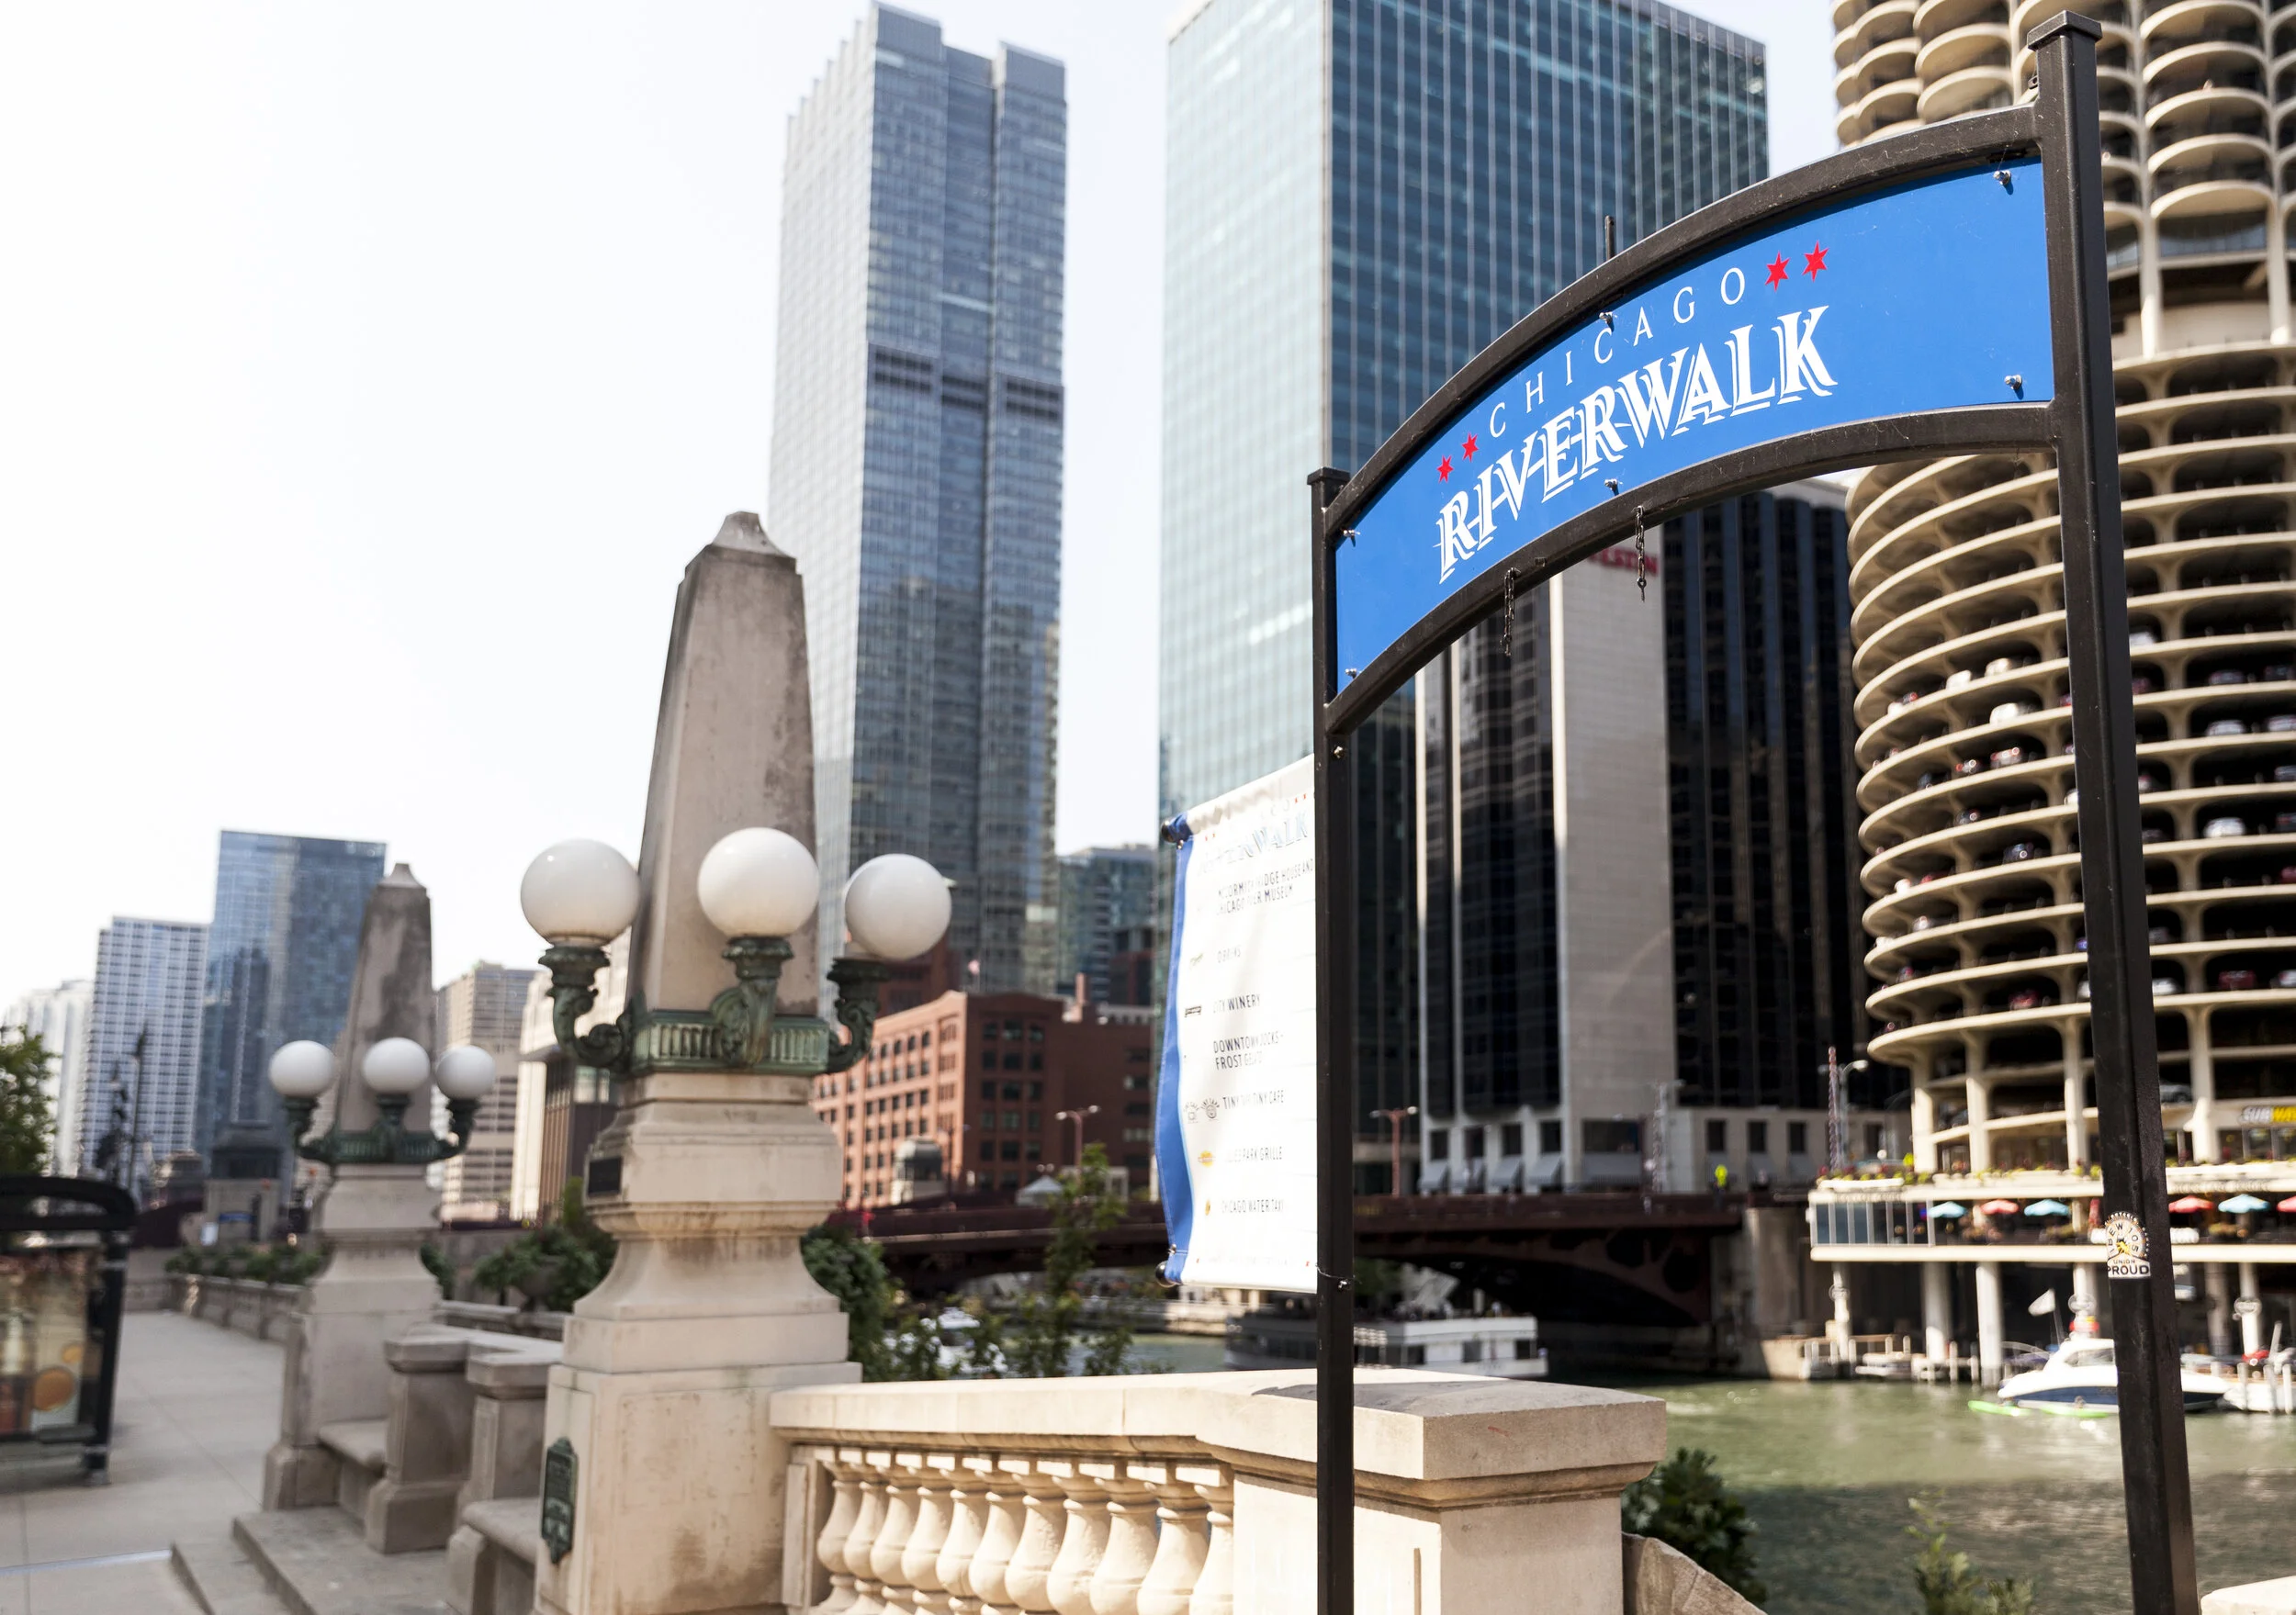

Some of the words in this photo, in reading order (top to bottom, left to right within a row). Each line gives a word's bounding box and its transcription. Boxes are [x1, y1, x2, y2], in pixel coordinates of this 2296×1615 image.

[1490, 267, 1745, 438] CHICAGO
[1435, 305, 1838, 584] RIVERWALK
[1264, 883, 1293, 903] MUSEUM
[1227, 993, 1261, 1011] WINERY
[1215, 1053, 1243, 1071] FROST
[2108, 1265, 2149, 1275] PROUD
